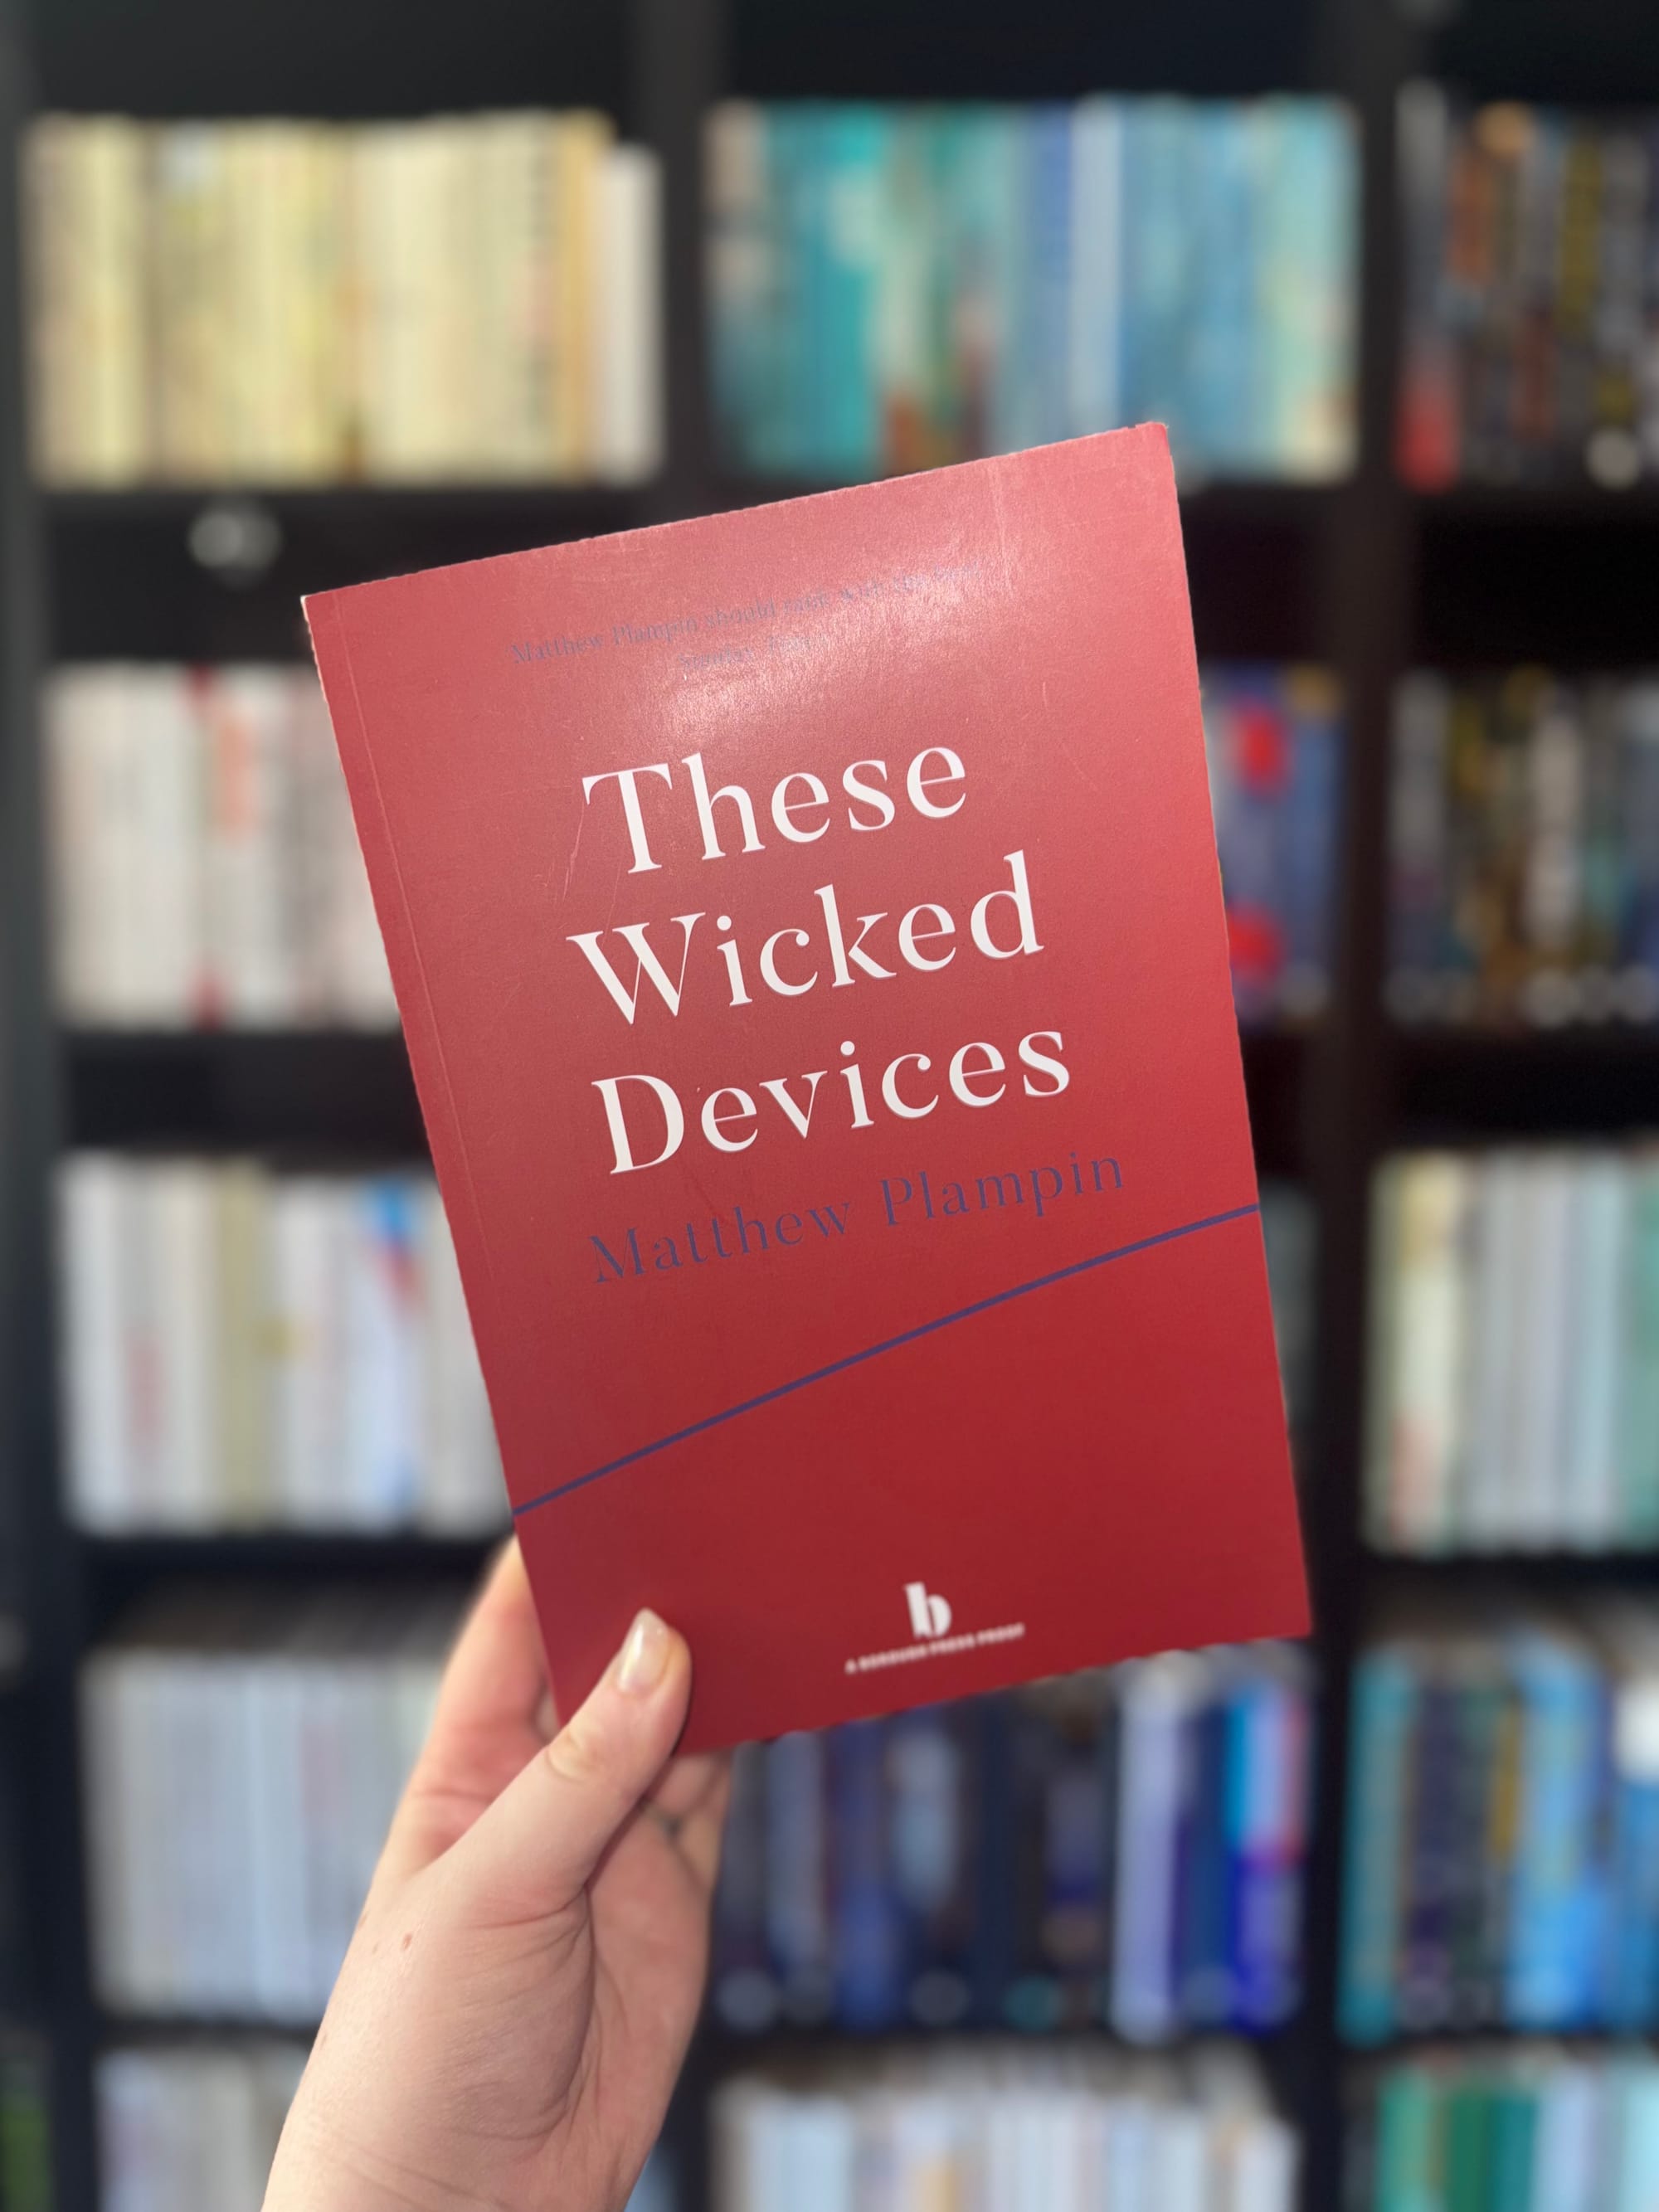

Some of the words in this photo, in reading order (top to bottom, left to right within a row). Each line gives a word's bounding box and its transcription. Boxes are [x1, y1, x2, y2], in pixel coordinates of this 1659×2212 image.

[705, 596, 776, 627] should
[582, 746, 966, 873] These
[566, 849, 1044, 1024] Wicked
[591, 1030, 1069, 1174] Devices
[588, 1201, 851, 1284] Matthew
[880, 1150, 1123, 1226] Plampin
[903, 1582, 952, 1639] b
